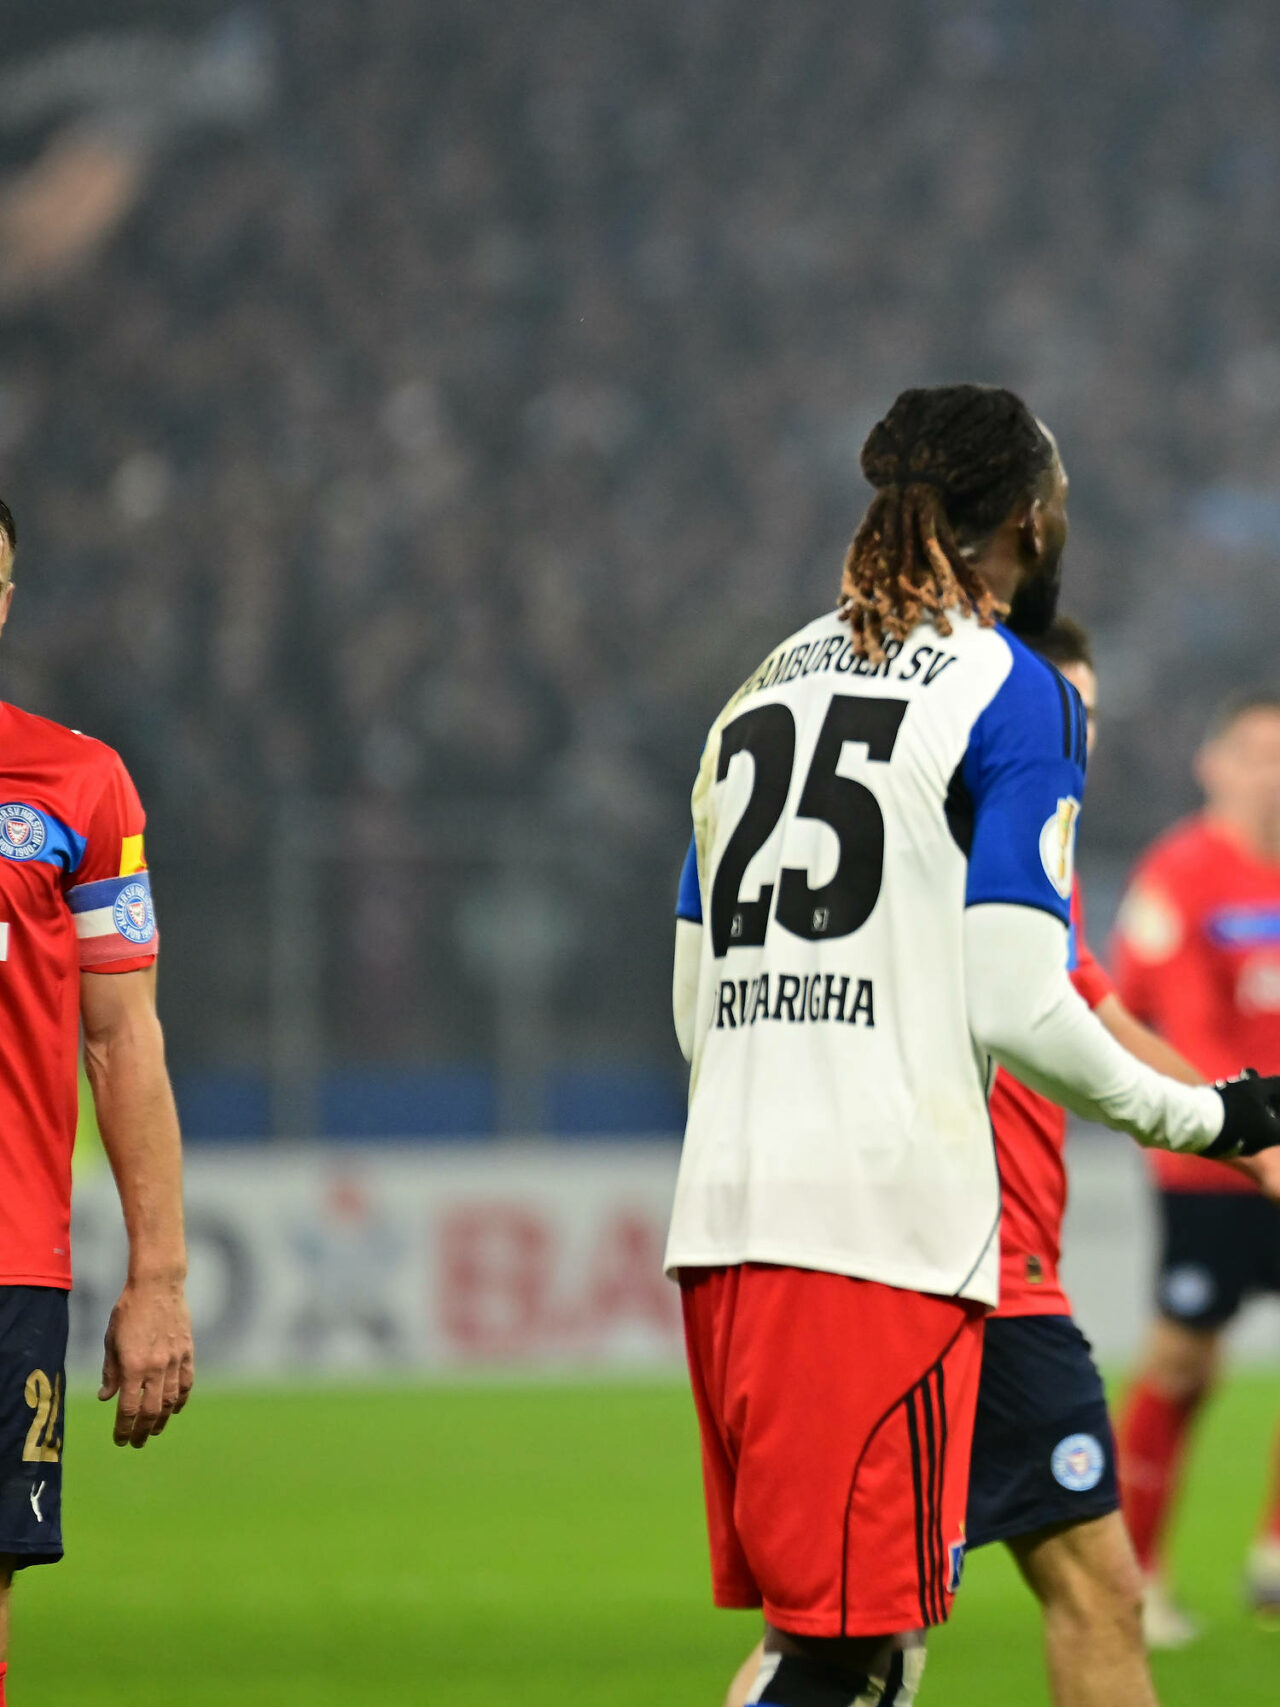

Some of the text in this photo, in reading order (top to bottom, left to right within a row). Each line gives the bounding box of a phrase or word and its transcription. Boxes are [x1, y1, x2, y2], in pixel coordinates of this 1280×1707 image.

[740, 635, 957, 692] AMBURGER SV
[710, 694, 910, 960] 25
